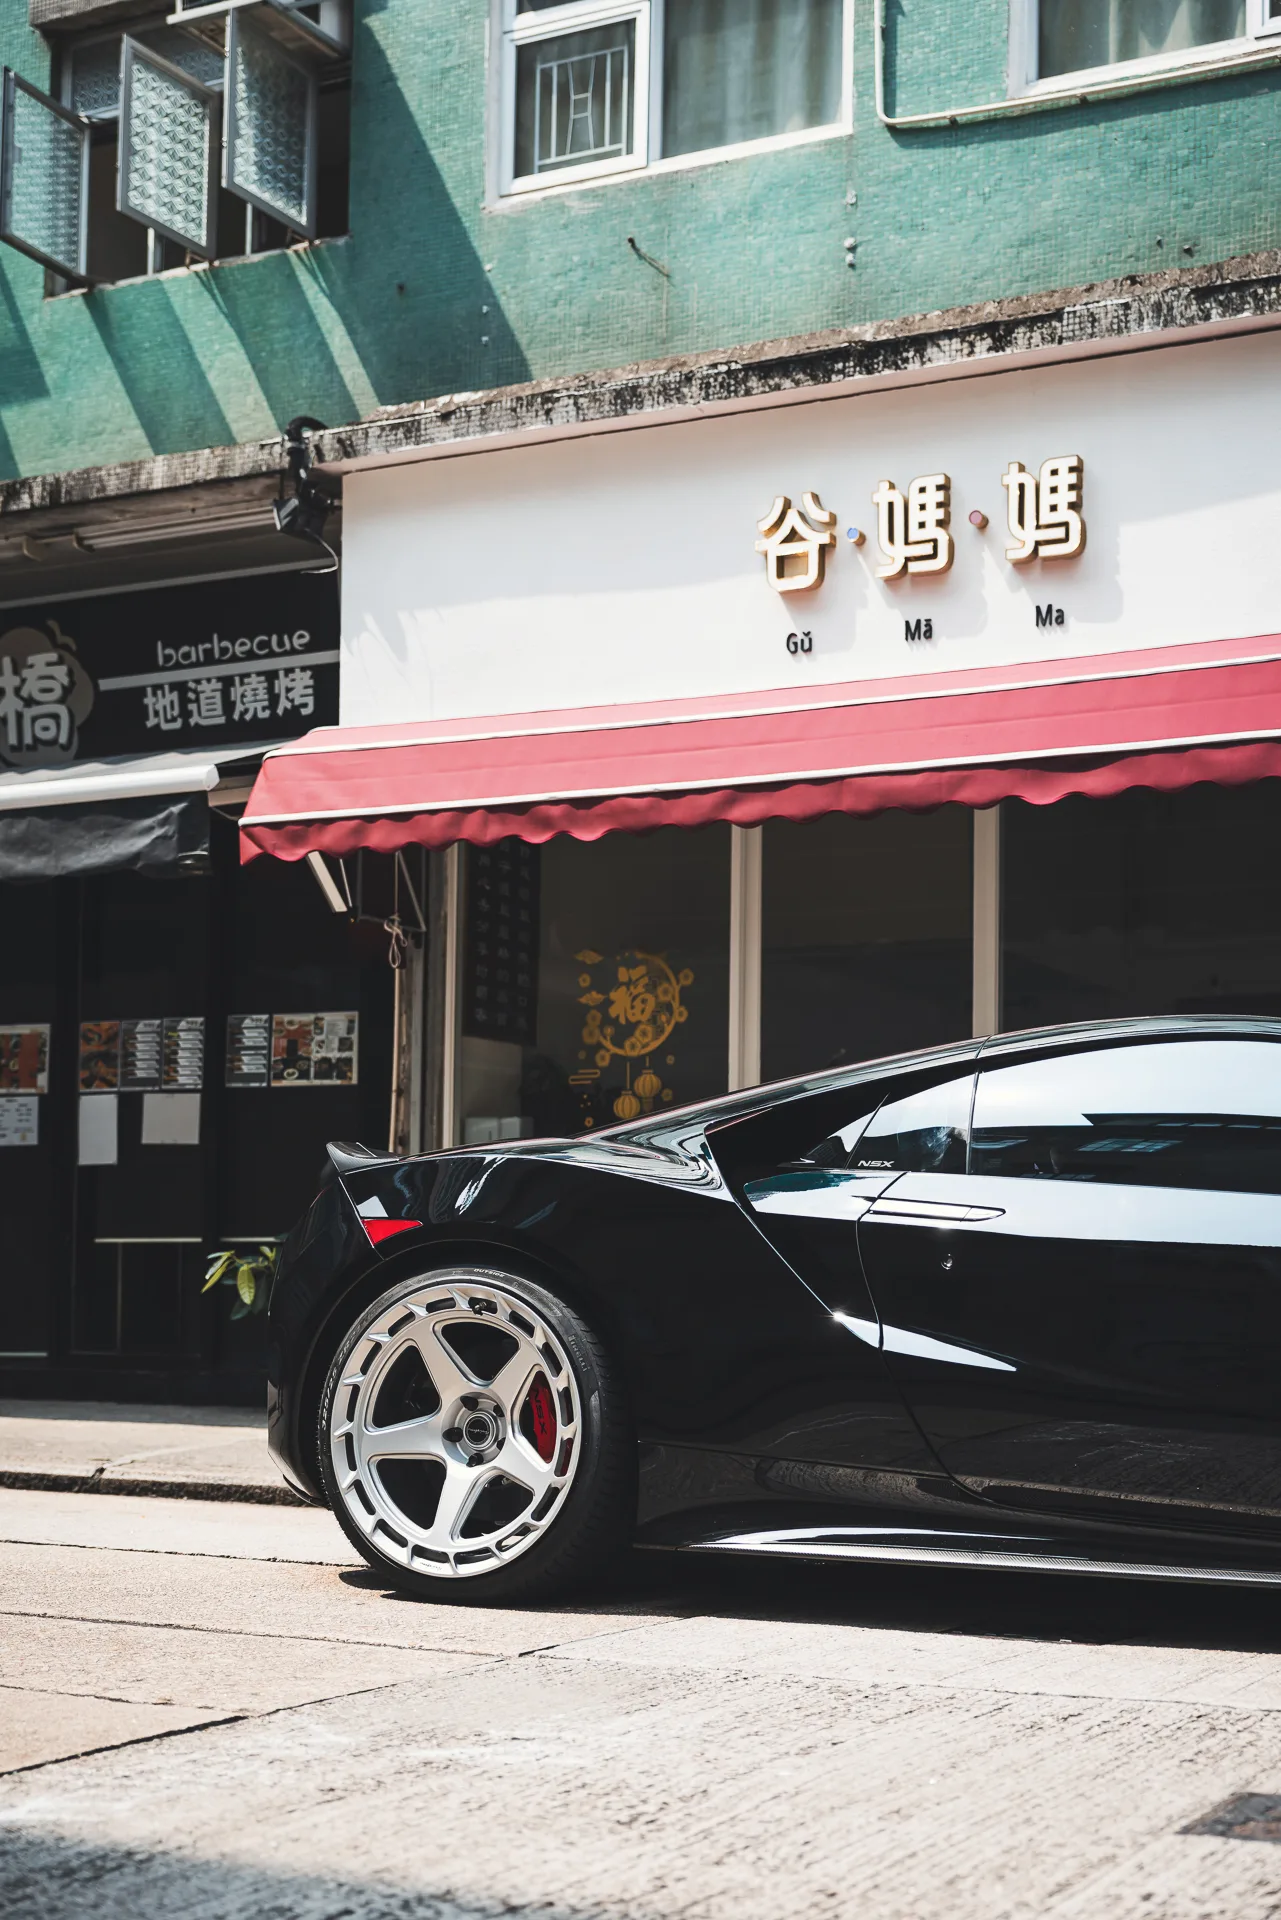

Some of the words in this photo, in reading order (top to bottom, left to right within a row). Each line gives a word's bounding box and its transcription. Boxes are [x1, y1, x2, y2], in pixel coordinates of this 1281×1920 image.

[905, 618, 933, 642] Mā
[1036, 604, 1065, 628] Ma
[157, 630, 310, 667] barbecue
[143, 668, 315, 731] 地道燒烤
[608, 965, 656, 1025] 福
[857, 1160, 895, 1168] NSX
[530, 1387, 548, 1435] NSX
